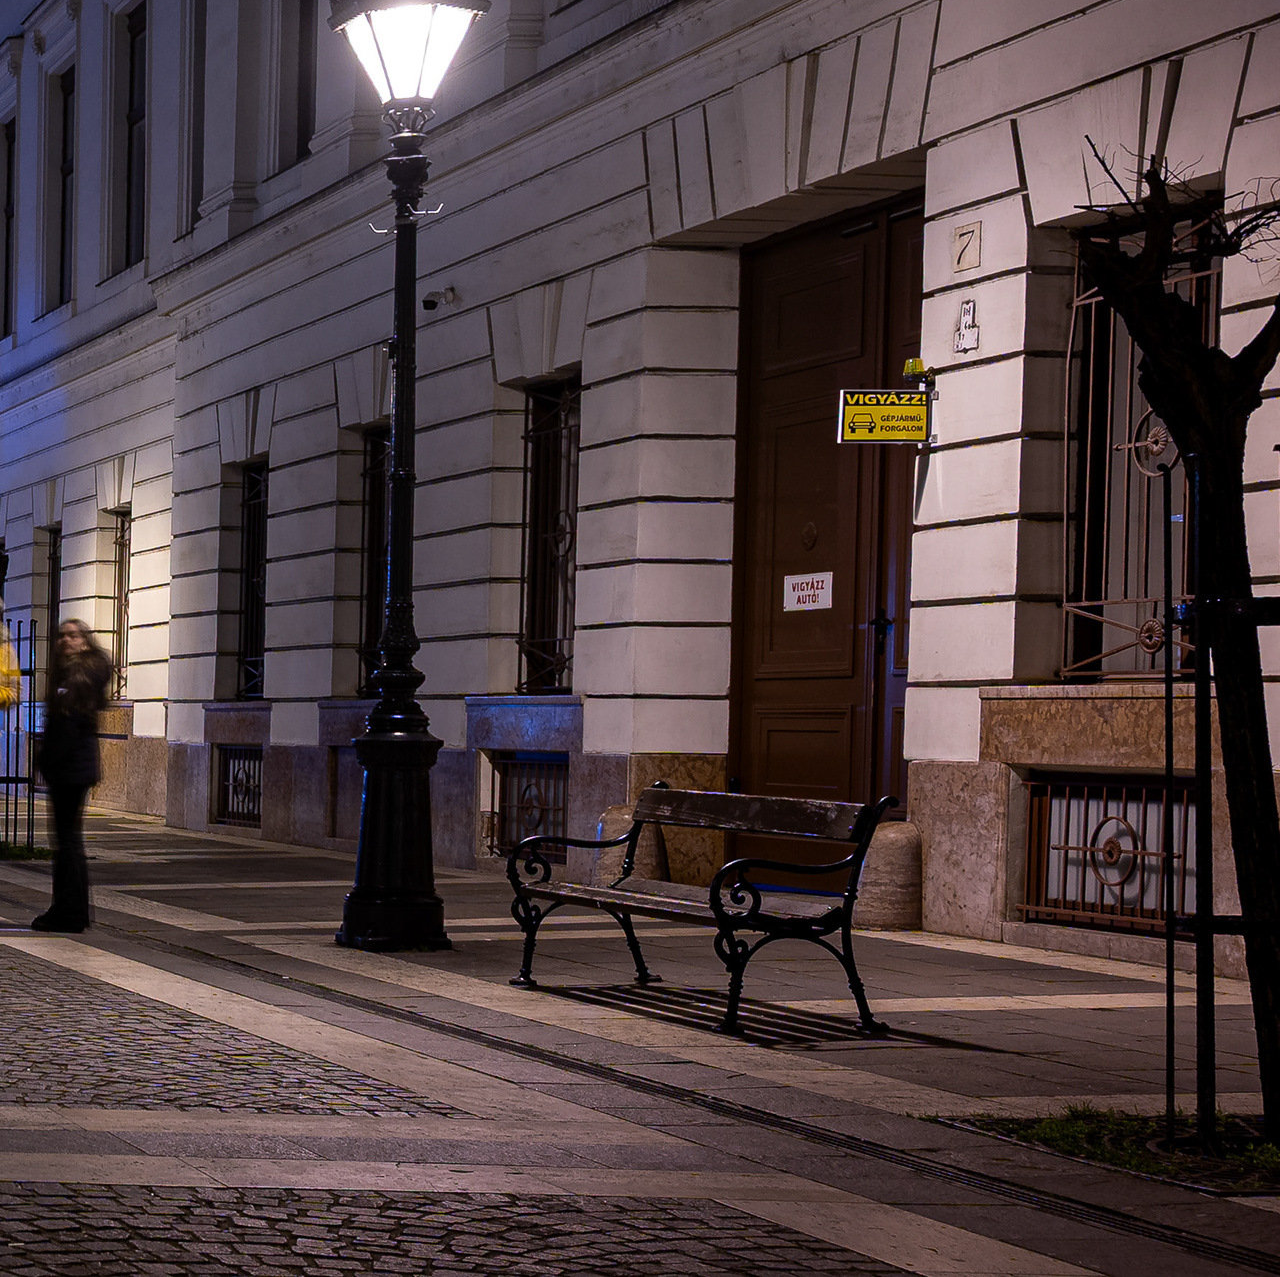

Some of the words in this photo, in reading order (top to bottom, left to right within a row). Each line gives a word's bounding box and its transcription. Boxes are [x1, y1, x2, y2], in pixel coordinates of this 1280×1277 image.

[956, 229, 975, 266] 7
[845, 391, 927, 405] VIGYÁZZ!
[791, 577, 825, 592] VIGYÁZZ
[796, 590, 819, 605] AUTÓ!
